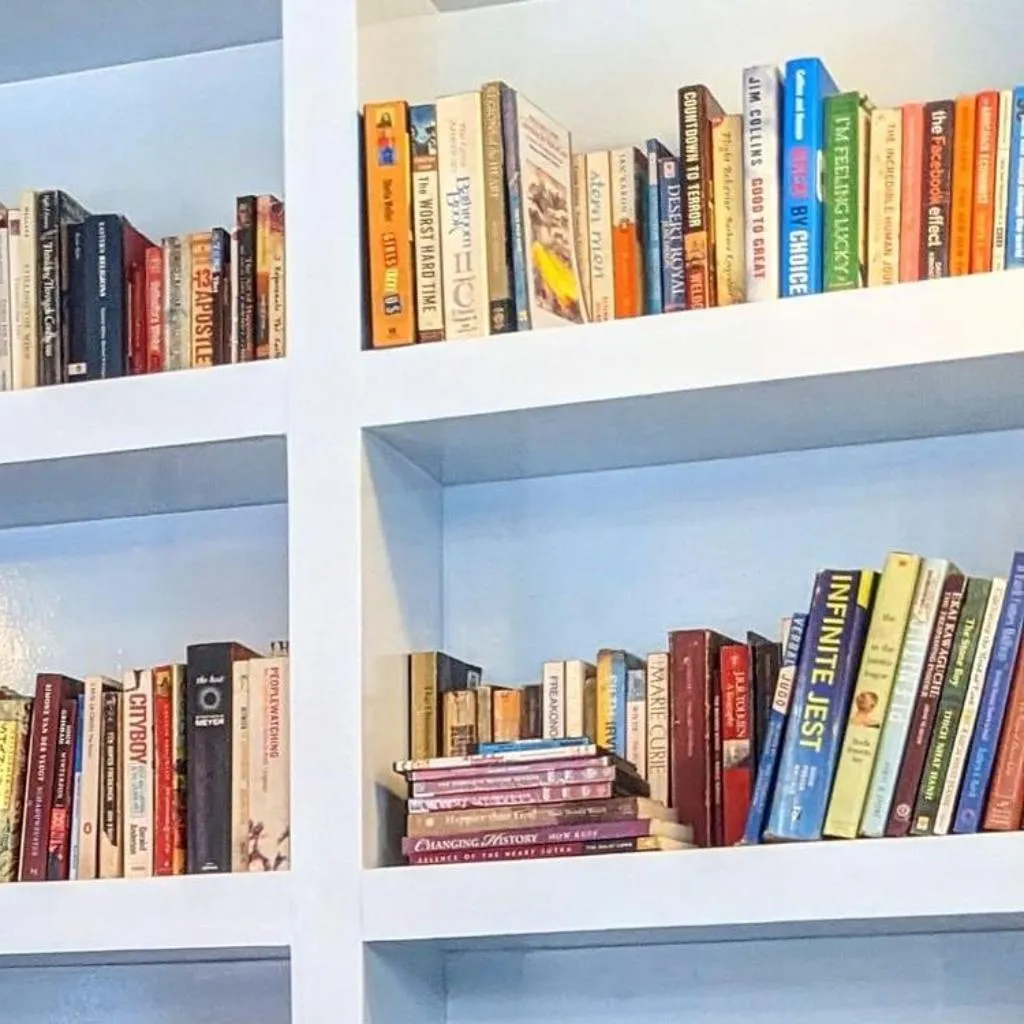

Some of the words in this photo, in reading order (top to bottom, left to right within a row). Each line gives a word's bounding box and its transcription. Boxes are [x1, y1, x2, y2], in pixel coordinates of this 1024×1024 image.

[749, 77, 761, 103] JIM
[683, 91, 700, 162] COUNTDOWN
[750, 110, 762, 166] COLLINS
[835, 116, 852, 141] I'M
[886, 124, 896, 145] THE
[931, 110, 946, 134] the
[419, 176, 429, 195] The
[685, 165, 699, 180] TO
[834, 146, 850, 214] FEELING
[884, 149, 895, 214] INCREDIBLE
[929, 136, 946, 205] Facebook
[667, 184, 683, 243] DESERT
[686, 183, 701, 227] TERROR
[752, 178, 764, 213] GOOD
[790, 205, 808, 226] BY
[420, 199, 434, 240] WORST
[753, 219, 765, 234] TO
[883, 217, 892, 256] HUMAN
[927, 207, 945, 247] effect
[382, 232, 397, 268] GIRLS
[421, 245, 435, 278] HARD
[591, 231, 606, 279] men
[754, 238, 765, 279] GREAT
[789, 230, 808, 295] CHOICE
[835, 219, 849, 271] LUCKY
[671, 247, 685, 299] ROYAL
[423, 283, 436, 313] TIME
[196, 291, 213, 363] APOSTLE
[783, 618, 805, 664] VERBAL
[811, 574, 854, 685] INFINITE
[964, 618, 975, 635] The
[956, 636, 971, 666] Stone
[649, 666, 665, 720] MARIE
[775, 673, 792, 707] JUDO
[949, 668, 965, 688] Boy
[41, 717, 51, 734] VAN
[129, 694, 147, 765] CITYBOY
[269, 667, 280, 758] PEOPLEWATCHING
[735, 696, 745, 738] TOLKIEN
[799, 691, 830, 752] JEST
[40, 736, 50, 753] DER
[649, 724, 665, 773] CURIE
[414, 837, 487, 853] CHANGING
[481, 832, 538, 849] HISTORY
